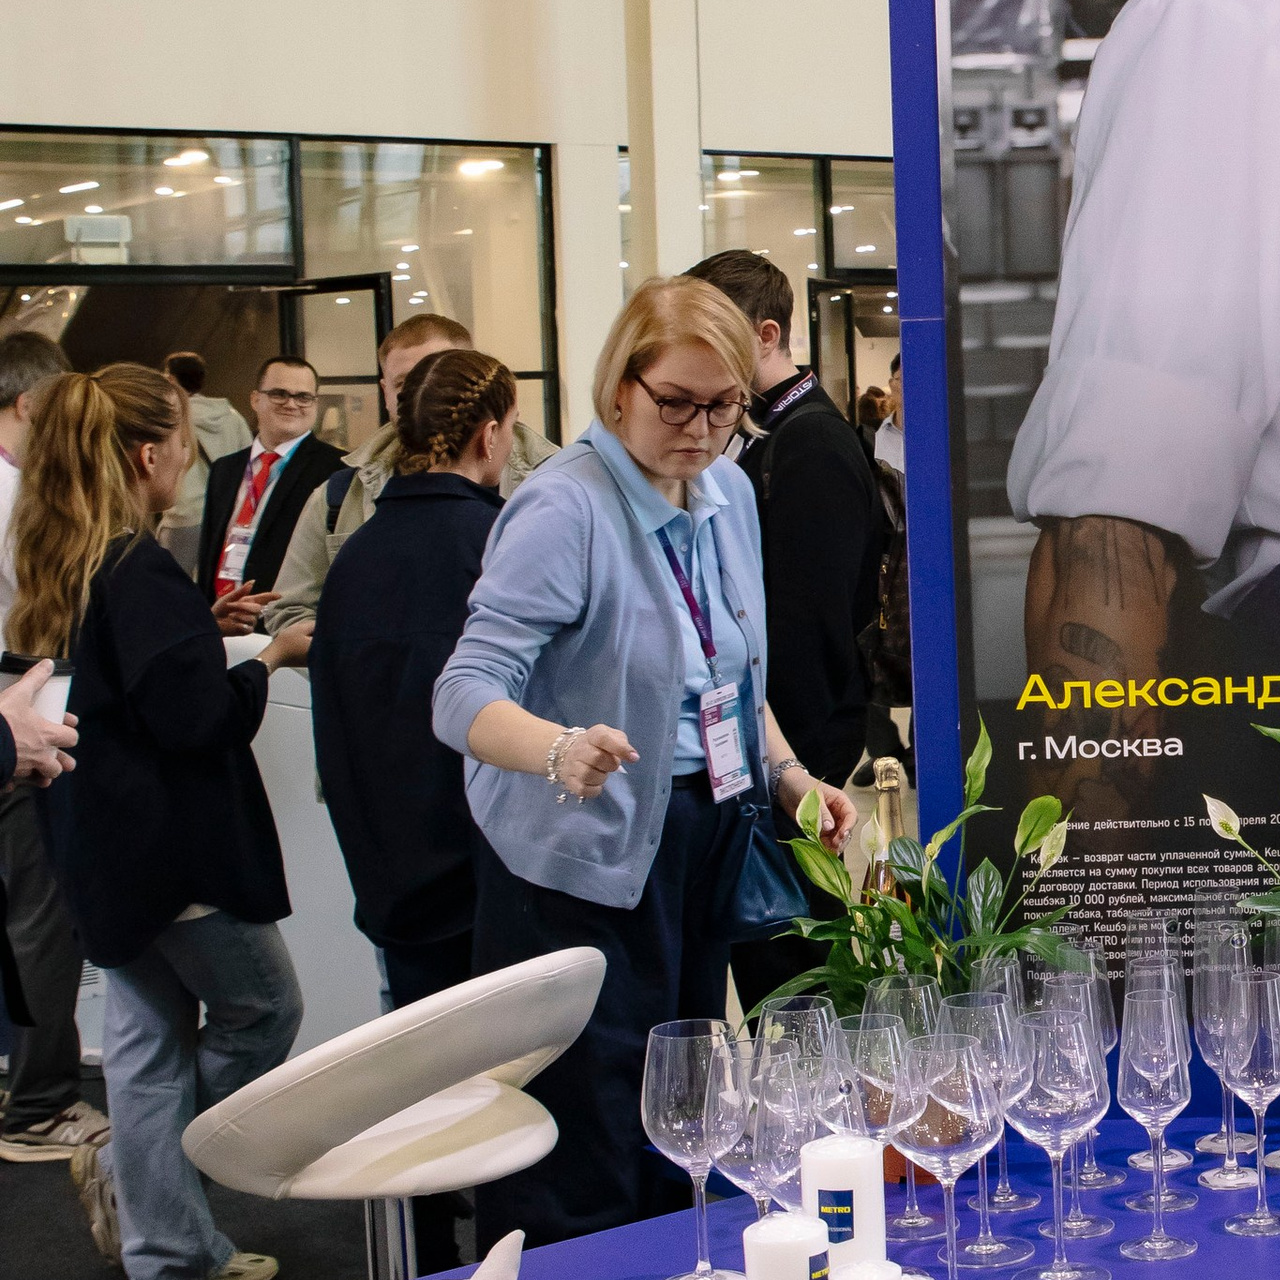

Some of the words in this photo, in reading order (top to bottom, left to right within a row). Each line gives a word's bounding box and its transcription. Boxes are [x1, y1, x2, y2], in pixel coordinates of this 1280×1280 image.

[1018, 741, 1037, 761] г.
[1044, 735, 1184, 760] Москва
[1093, 817, 1170, 831] действительно
[1174, 819, 1180, 828] с
[1183, 816, 1195, 827] 15
[1240, 816, 1267, 828] преля
[1084, 853, 1124, 865] возврат
[1127, 852, 1156, 861] части
[1160, 847, 1221, 862] уплаченной
[1022, 868, 1086, 878] начисляется
[1089, 867, 1101, 876] на
[1105, 866, 1137, 878] сумму
[1142, 865, 1184, 877] покупки
[1188, 864, 1209, 873] всех
[1214, 863, 1253, 875] товаров
[1039, 882, 1085, 894] договору
[1089, 880, 1138, 892] доставки.
[1142, 877, 1179, 891] Период
[1183, 877, 1259, 888] использования
[1023, 894, 1066, 906] кешбэка
[1069, 894, 1081, 905] 10
[1084, 893, 1105, 904] 000
[1108, 892, 1147, 906] рублей,
[1068, 906, 1104, 921] табака,
[820, 1205, 851, 1214] METRO
